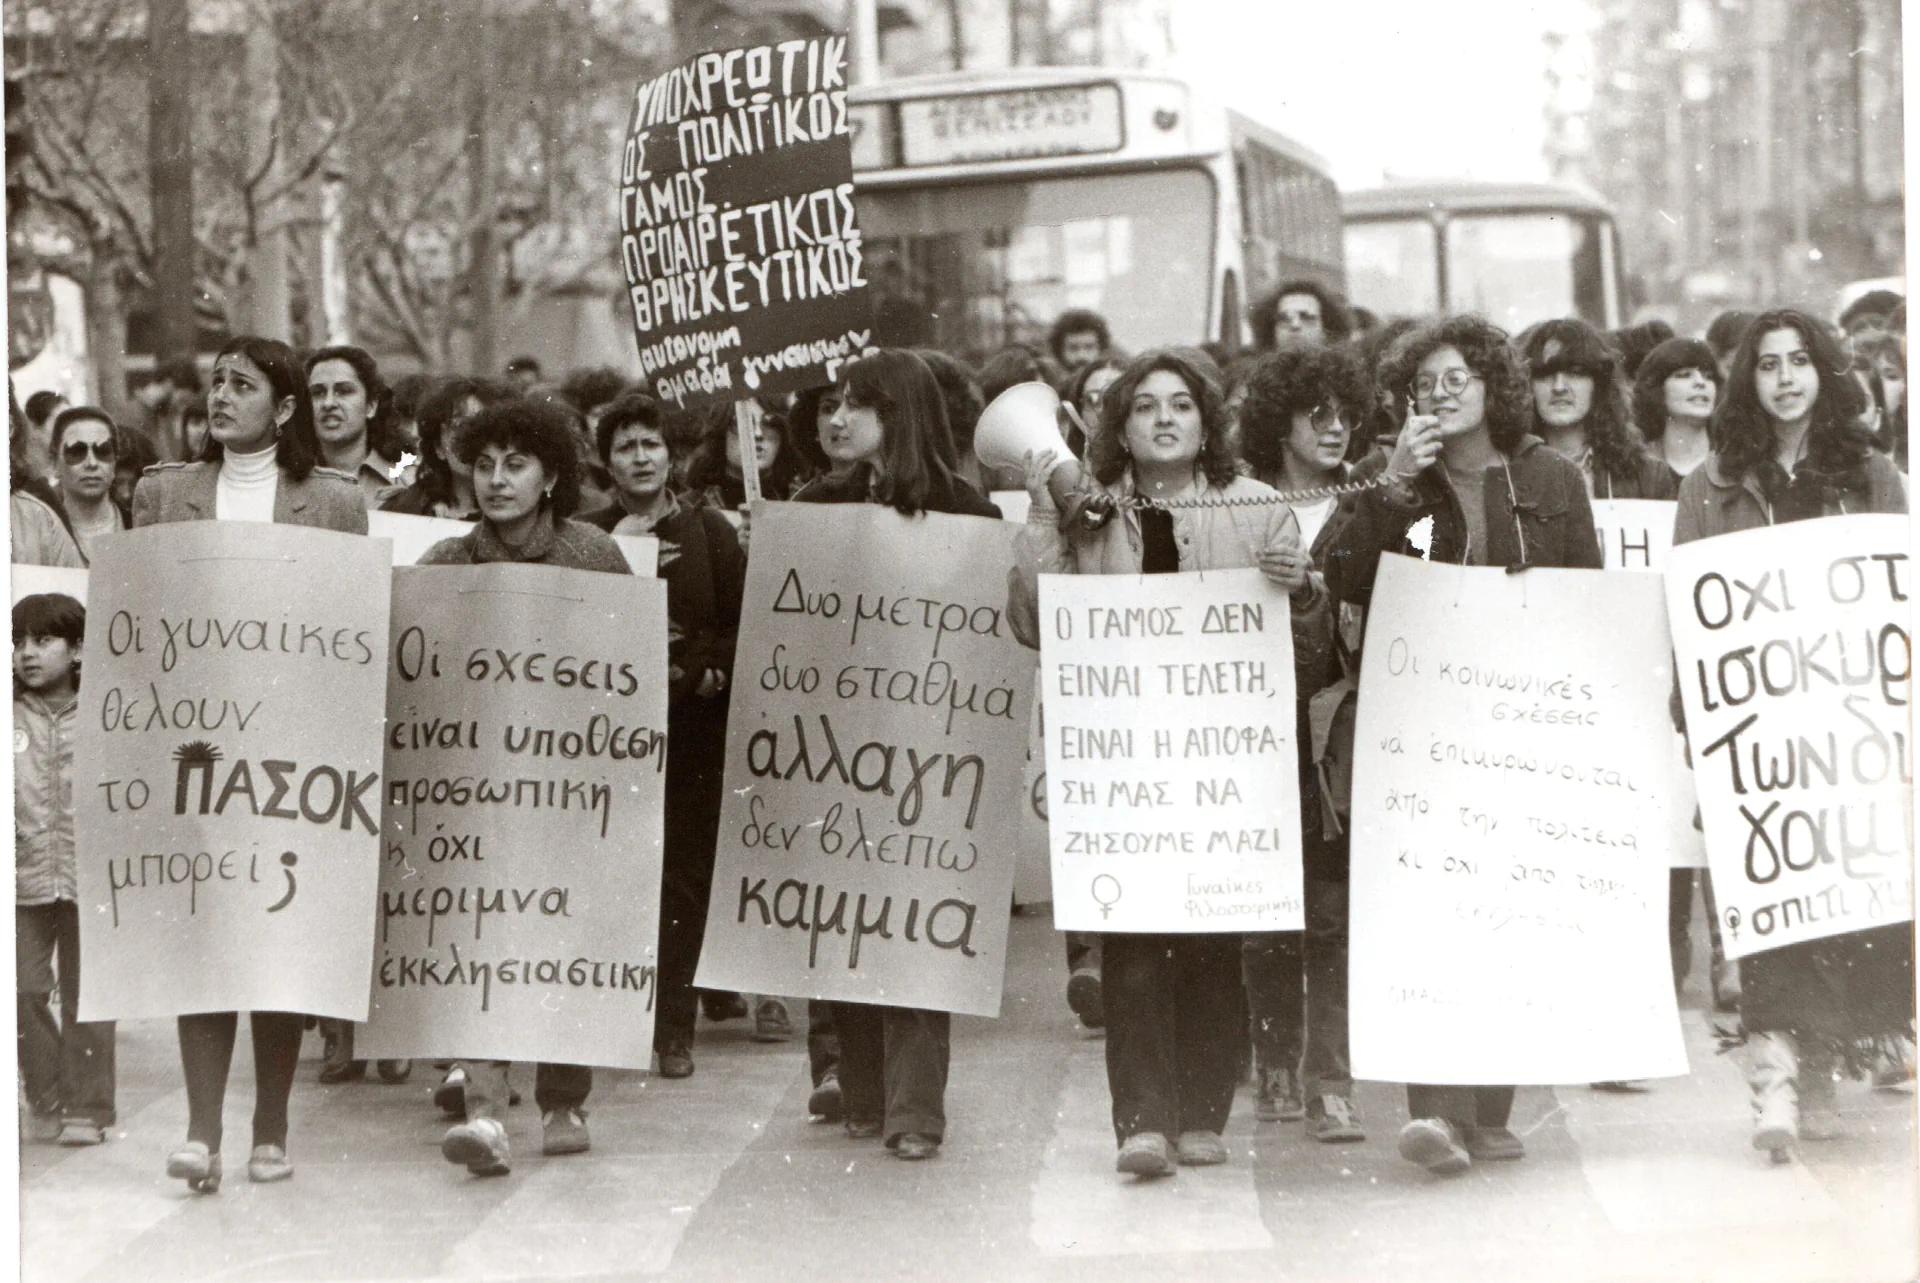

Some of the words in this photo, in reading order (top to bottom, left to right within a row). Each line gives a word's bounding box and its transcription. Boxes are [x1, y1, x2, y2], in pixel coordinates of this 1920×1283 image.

[623, 131, 652, 185] ΟΣ
[677, 91, 849, 169] ΠΟΛΙΤΙΚΟΣ
[620, 168, 718, 231] ΓΑΜΟΣ
[631, 239, 867, 331] ΘΡΗΣΚΕΥΤΙΚΟΣ
[1056, 606, 1072, 640] Ο
[1088, 606, 1185, 639] ΓΑΜΟΣ
[1200, 603, 1264, 634] ΔΕΝ
[1058, 663, 1140, 698] ΕΙΝΑΙ
[1157, 661, 1276, 698] ΤΕΛΕΤΗ,
[1060, 726, 1134, 759] ΕΙΝΑΙ
[1153, 729, 1172, 759] Η
[1183, 725, 1286, 757] ΑΠΟΦΑ-
[172, 744, 380, 836] ΠΑΣΟΚ
[1061, 780, 1096, 805] ΣΗ
[1108, 780, 1175, 807] ΜΑΣ
[1195, 777, 1242, 806] ΝΑ
[1063, 831, 1195, 854] ΖΗΣΟΥΜΕ
[1206, 828, 1280, 854] ΜΑΖΙ
